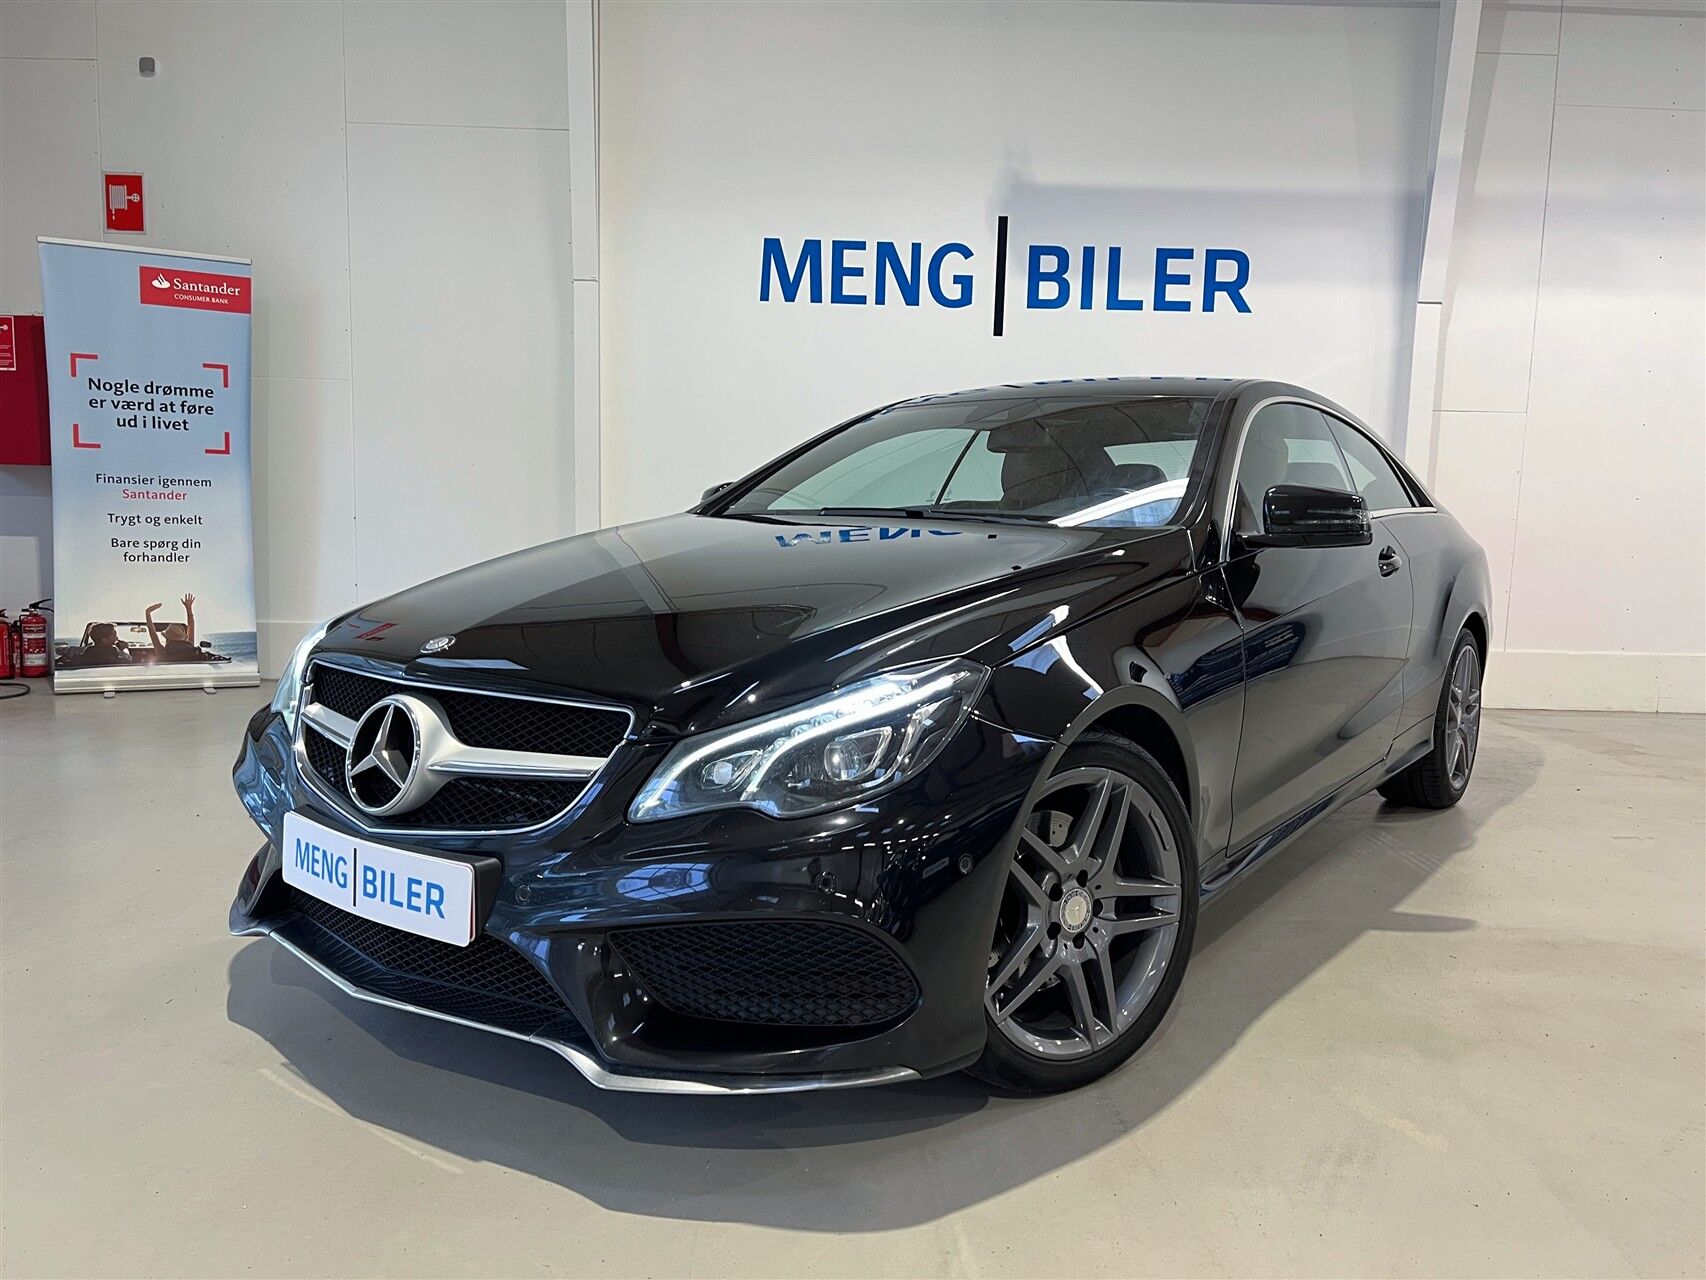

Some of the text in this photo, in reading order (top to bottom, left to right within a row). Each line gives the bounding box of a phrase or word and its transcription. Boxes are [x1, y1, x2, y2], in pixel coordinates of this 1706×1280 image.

[760, 237, 1253, 314] MENG BILER
[173, 278, 241, 296] Santander
[174, 293, 229, 305] CONSUMER BANK
[88, 377, 214, 399] Nogle drømme
[88, 397, 214, 415] er værd at føre
[116, 415, 190, 431] ud i livet
[96, 473, 212, 488] Finansier igennem
[122, 489, 188, 501] Santander
[107, 512, 203, 527] Trygt og enkelt
[111, 537, 201, 551] Bare spørg din
[123, 552, 191, 563] forhandler
[294, 837, 446, 920] MENG BILER
